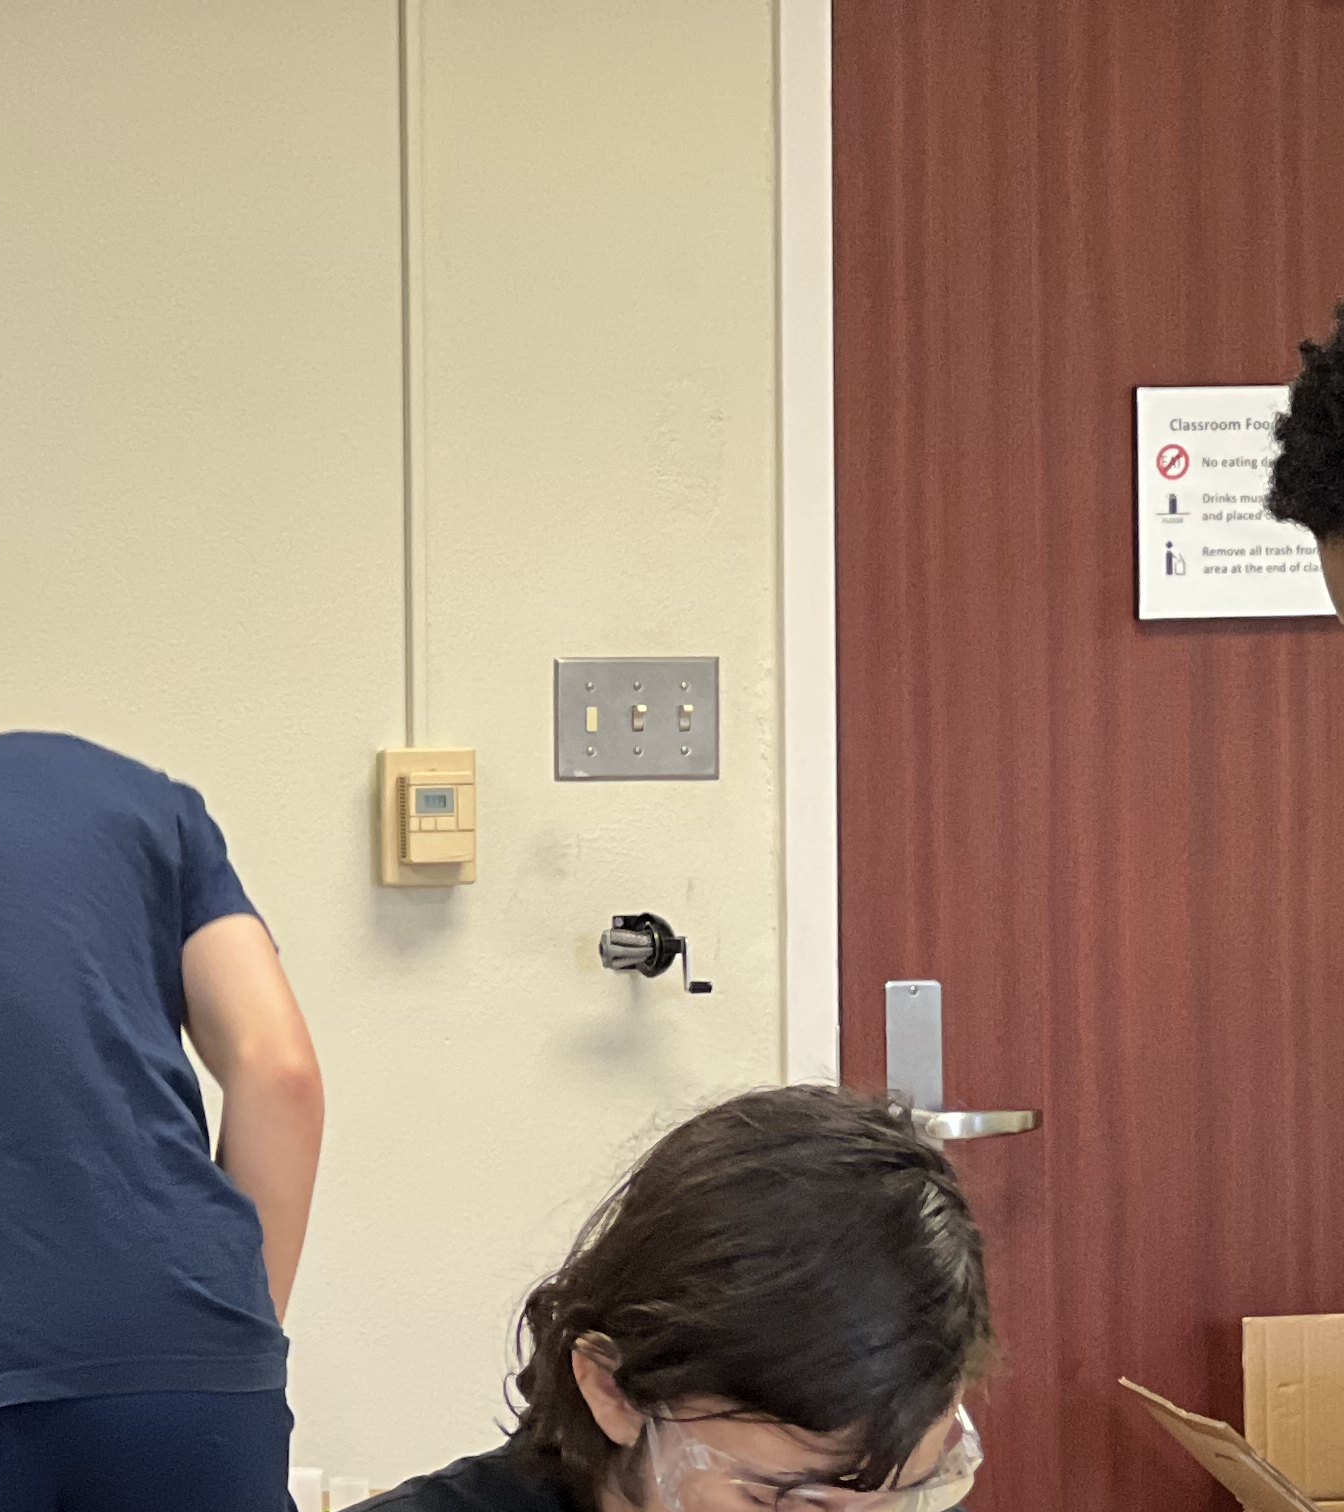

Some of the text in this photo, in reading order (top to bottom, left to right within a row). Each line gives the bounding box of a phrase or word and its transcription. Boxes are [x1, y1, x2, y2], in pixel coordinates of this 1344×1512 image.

[1169, 418, 1241, 432] Classroom
[1202, 457, 1218, 468] No
[1221, 456, 1258, 470] eating
[1202, 493, 1267, 504] Drinks mus
[1202, 510, 1223, 521] and
[1226, 510, 1262, 522] placed
[1202, 546, 1246, 556] Remove
[1249, 545, 1262, 556] all
[1265, 545, 1293, 556] trash
[1203, 562, 1322, 574] area at the end of cla
